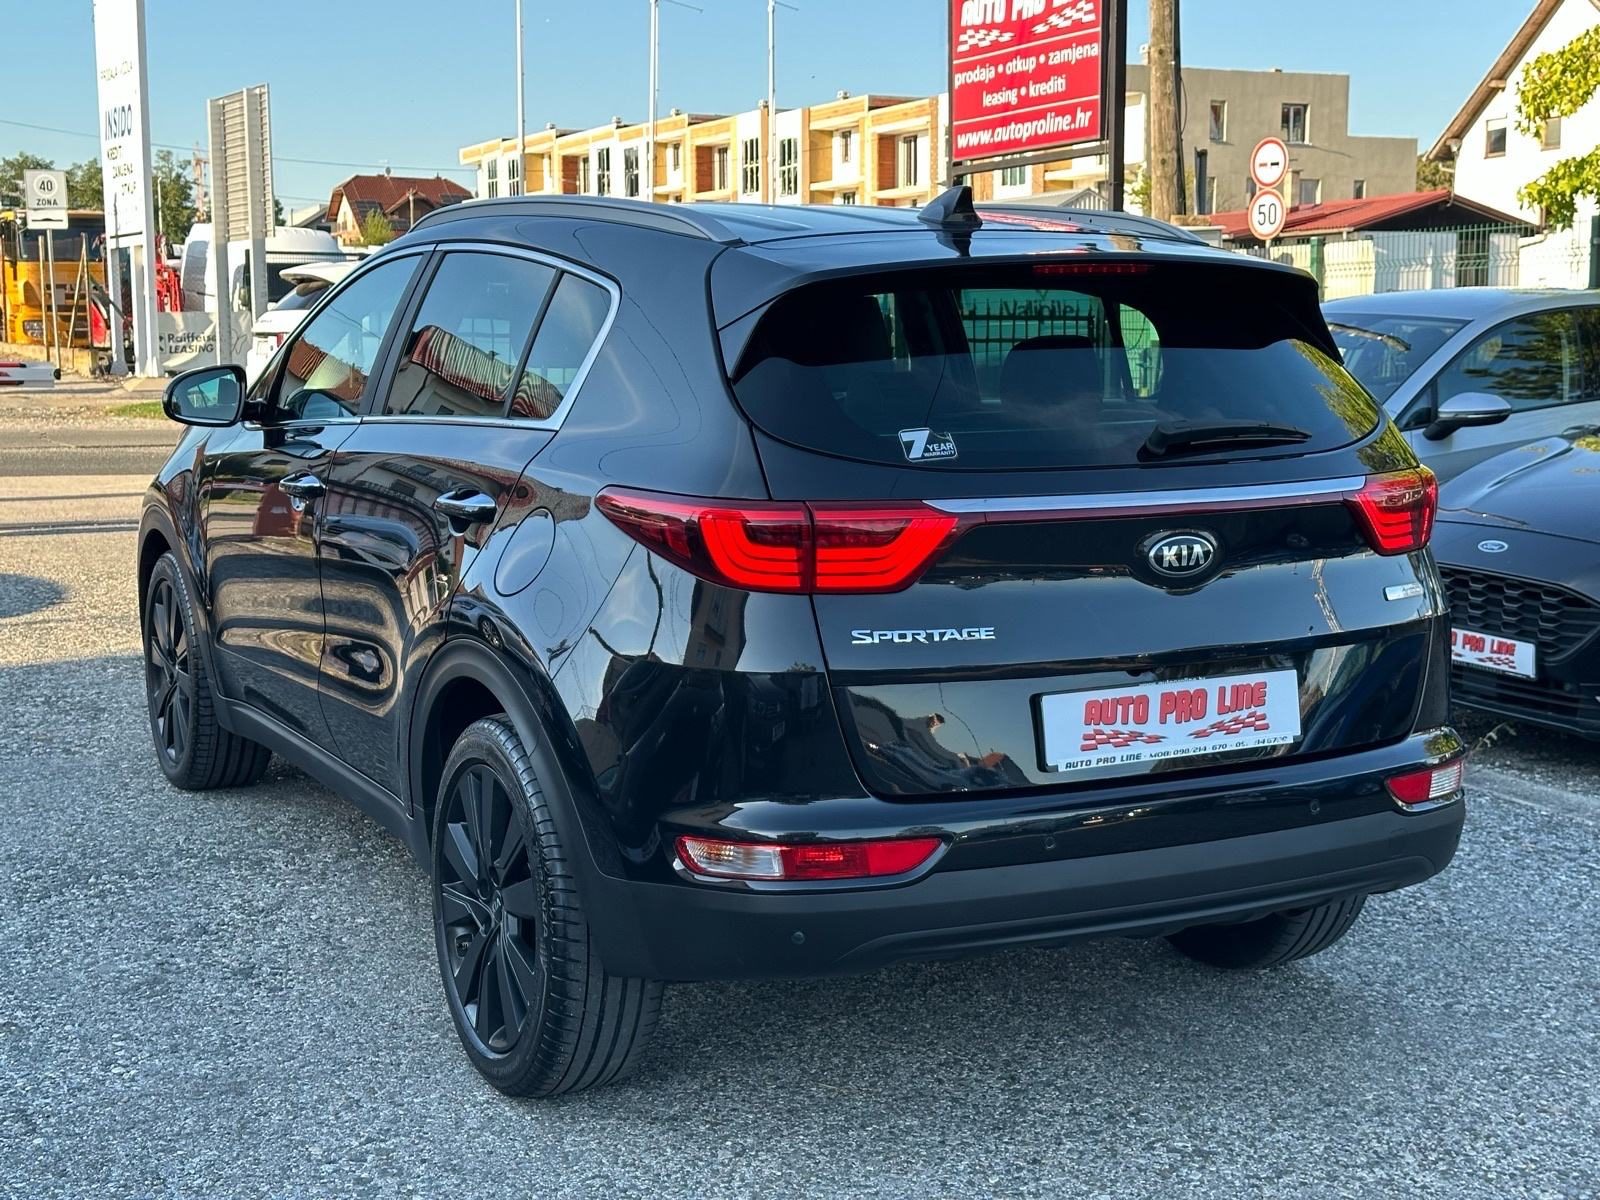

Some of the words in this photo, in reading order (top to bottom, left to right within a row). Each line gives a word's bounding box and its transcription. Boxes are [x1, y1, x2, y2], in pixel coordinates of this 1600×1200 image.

[960, 0, 1006, 26] AUTO
[954, 63, 995, 89] prodaja
[1005, 55, 1036, 74] otkup
[1048, 42, 1099, 65] zamjena
[982, 87, 1018, 107] leasing
[1028, 74, 1066, 97] krediti
[956, 106, 1093, 149] www.autoproline.hr
[39, 180, 53, 191] 40
[36, 198, 58, 206] ZONA
[1257, 202, 1277, 226] 50
[167, 332, 217, 343] Raiffeise
[169, 343, 214, 353] LEASING
[900, 430, 930, 459] 7
[926, 442, 954, 452] YEAR
[1161, 544, 1205, 568] KIA
[851, 627, 996, 644] SPORTAGE
[1462, 633, 1486, 653] PRO
[1489, 639, 1517, 656] LINE
[1083, 694, 1150, 726] AUTO
[1159, 688, 1208, 725] PRO
[1216, 681, 1267, 716] LINE
[1065, 759, 1092, 770] AUTO
[1096, 756, 1116, 765] PRO
[1120, 753, 1142, 762] LINE
